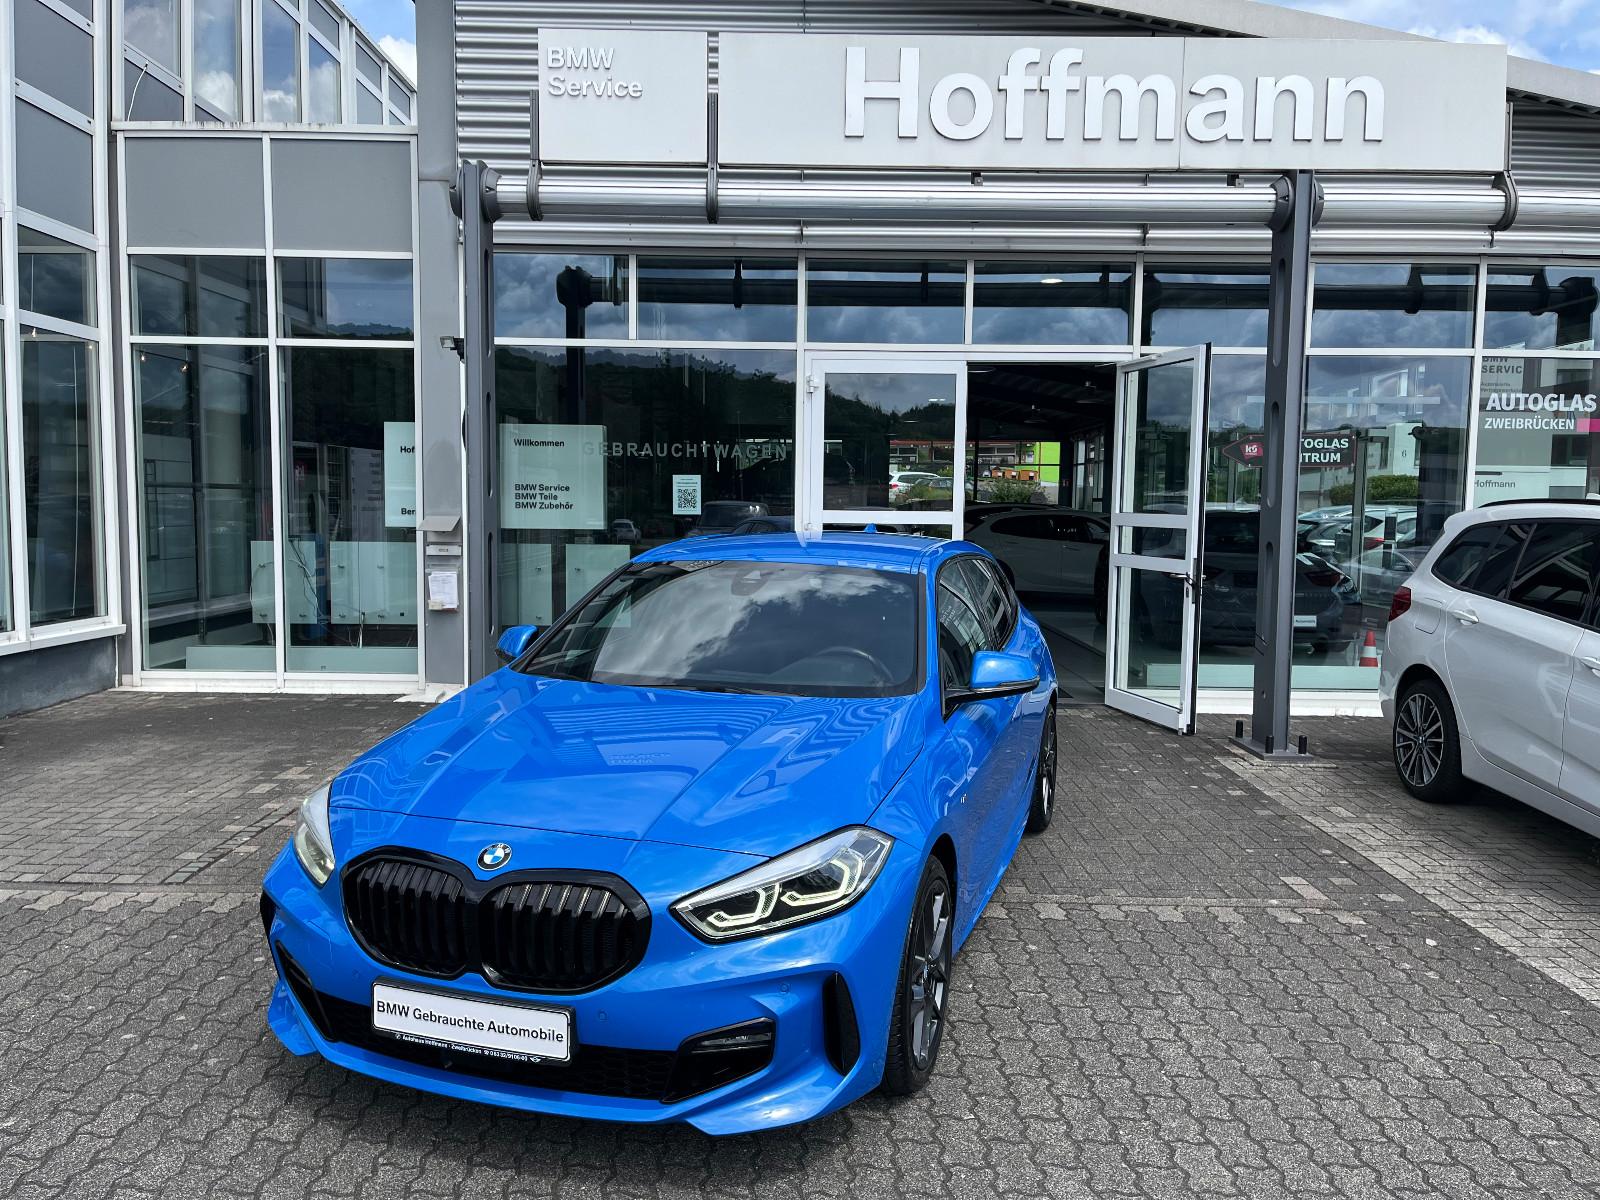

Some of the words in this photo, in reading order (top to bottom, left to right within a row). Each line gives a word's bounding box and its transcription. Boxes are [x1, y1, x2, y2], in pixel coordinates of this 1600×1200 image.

[547, 47, 615, 70] BMW
[548, 75, 643, 98] Service
[844, 46, 1386, 143] Hoffmann
[1485, 393, 1597, 412] AUTOGLAS
[1484, 415, 1575, 430] ZWEIBRÜCKEN
[513, 438, 565, 447] Willkommen
[583, 441, 787, 459] GEBRAUCHTWAGEN
[514, 483, 537, 491] BMW
[538, 483, 570, 492] Service
[514, 492, 537, 500] BMW
[539, 492, 558, 500] Teile
[514, 501, 537, 509] BMW
[538, 501, 574, 510] Zubehör
[376, 1000, 410, 1017] BMW
[413, 1007, 485, 1032] Gebrauchte
[487, 1020, 564, 1042] Automobile
